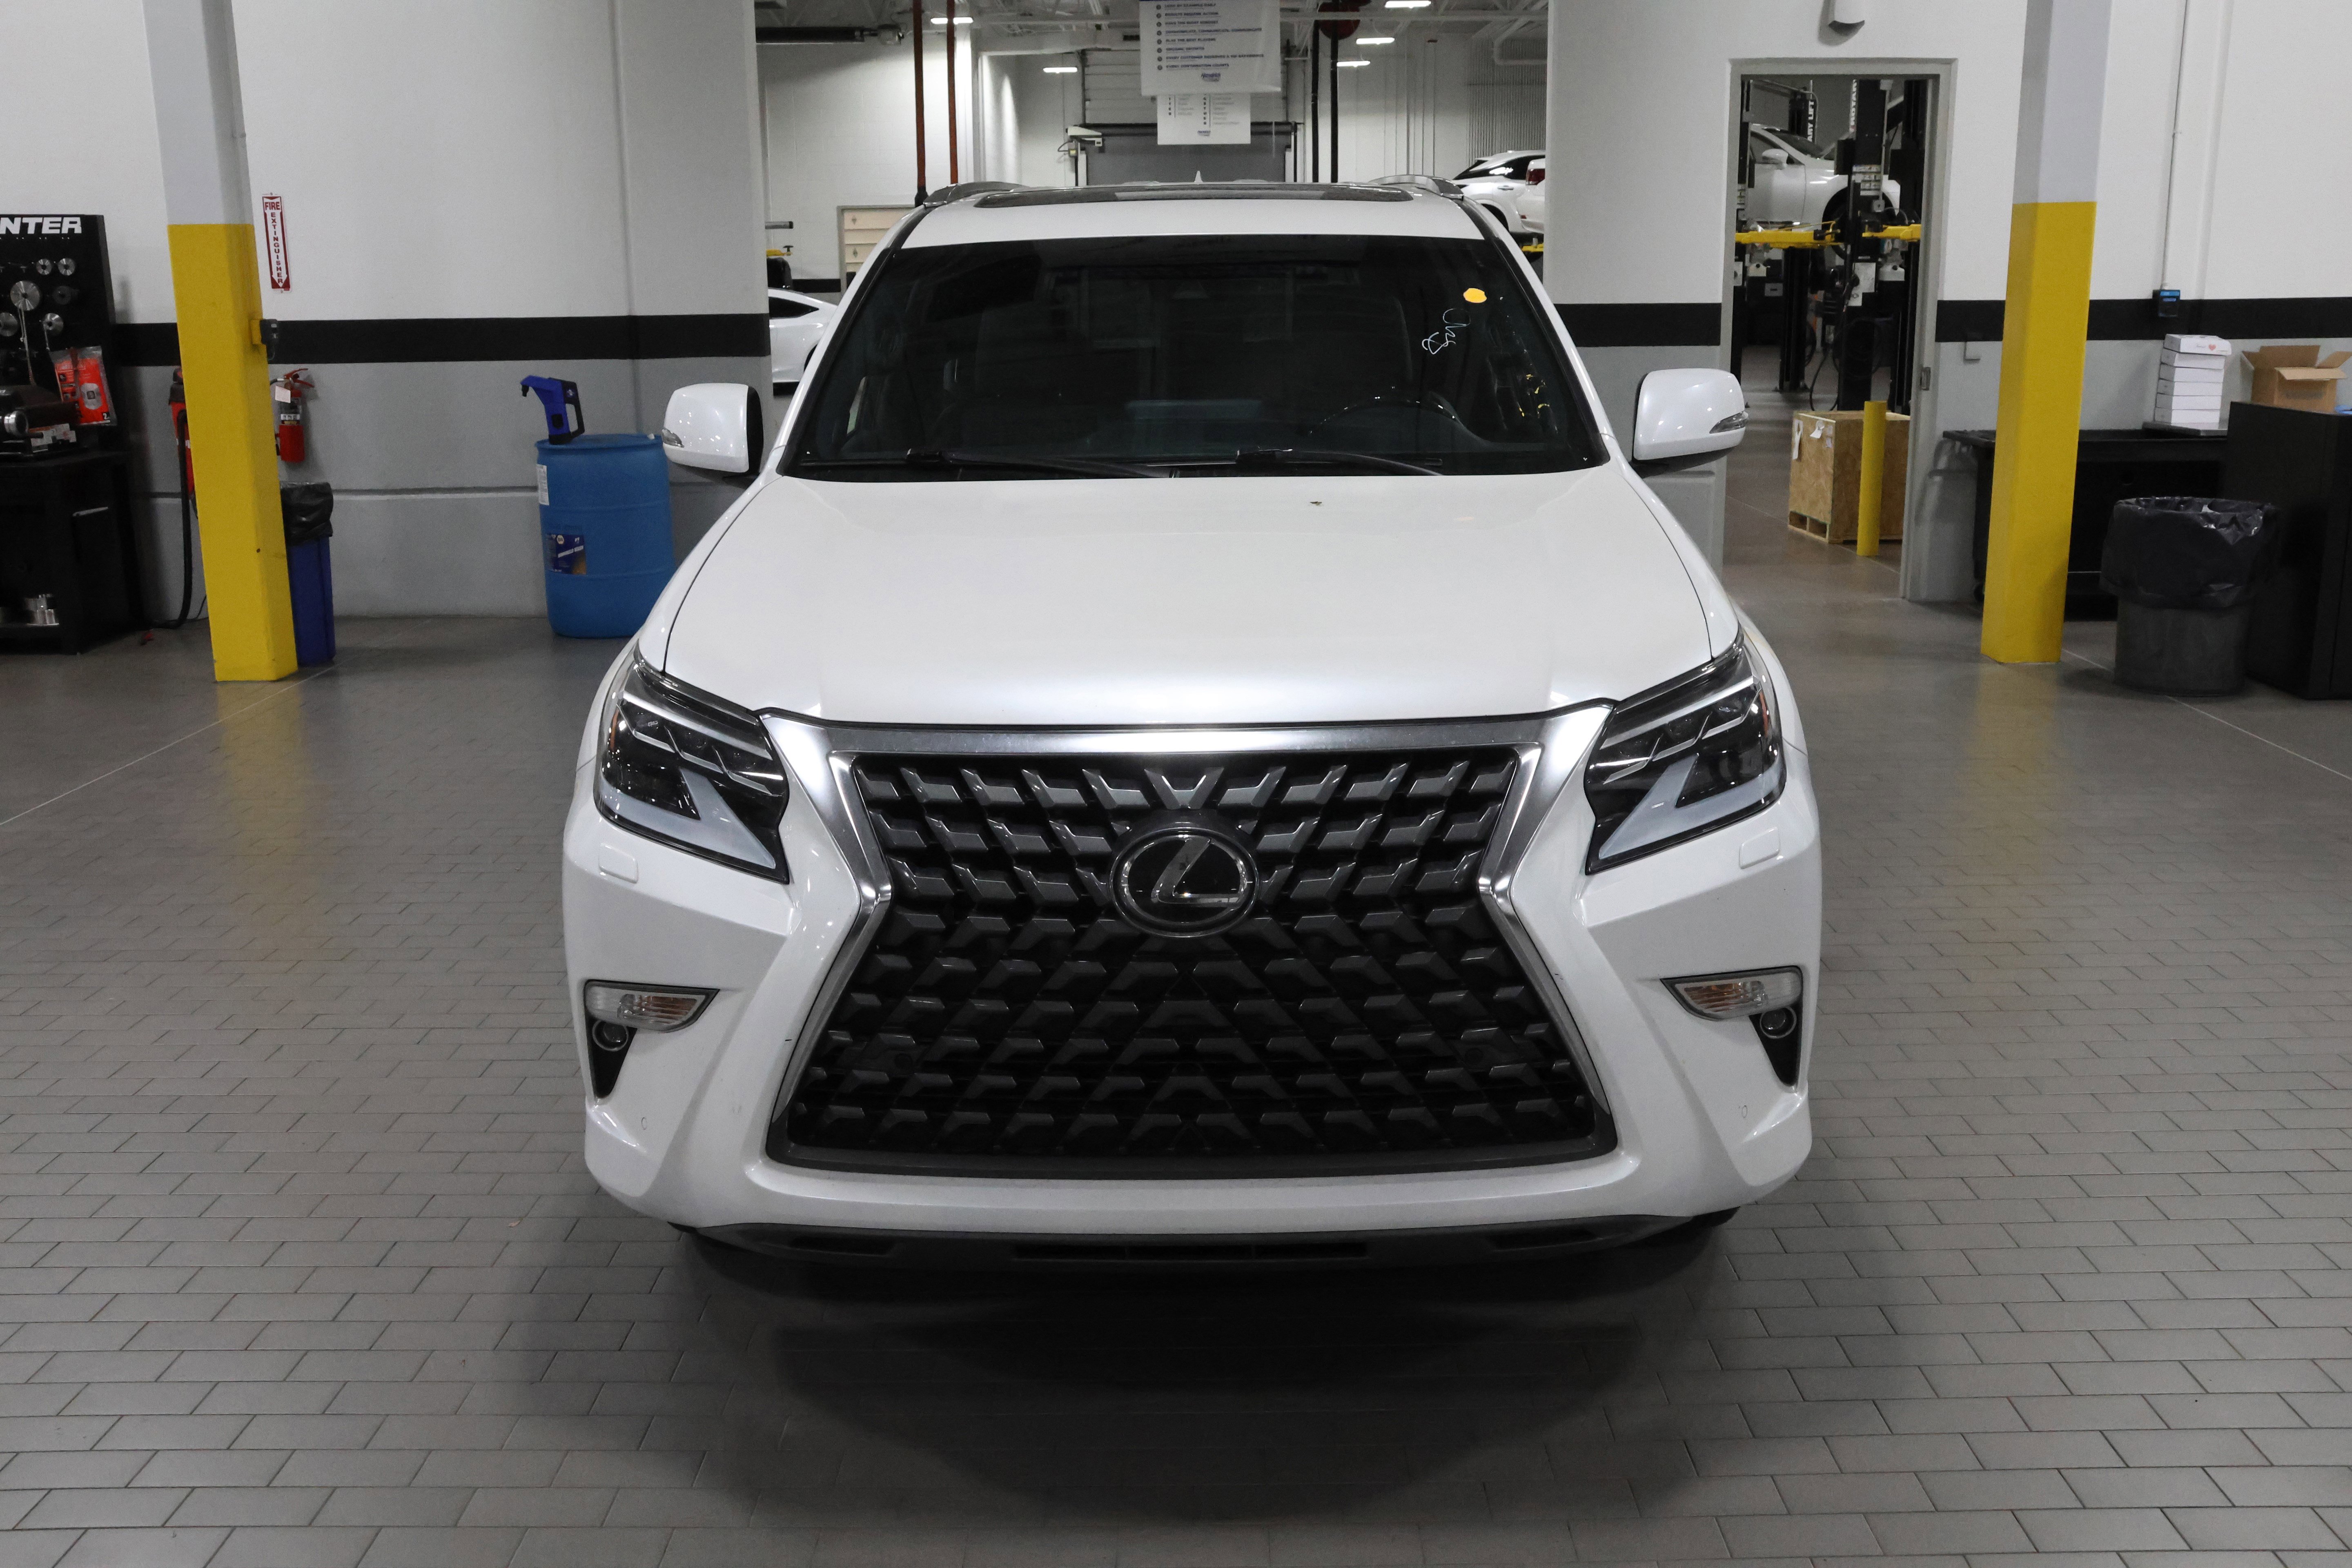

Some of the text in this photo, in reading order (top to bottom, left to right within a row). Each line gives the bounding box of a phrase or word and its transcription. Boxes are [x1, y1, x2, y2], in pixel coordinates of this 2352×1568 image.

[265, 202, 281, 210] FIRE
[0, 217, 82, 234] NTER
[270, 212, 283, 284] EXTINGUISHER
